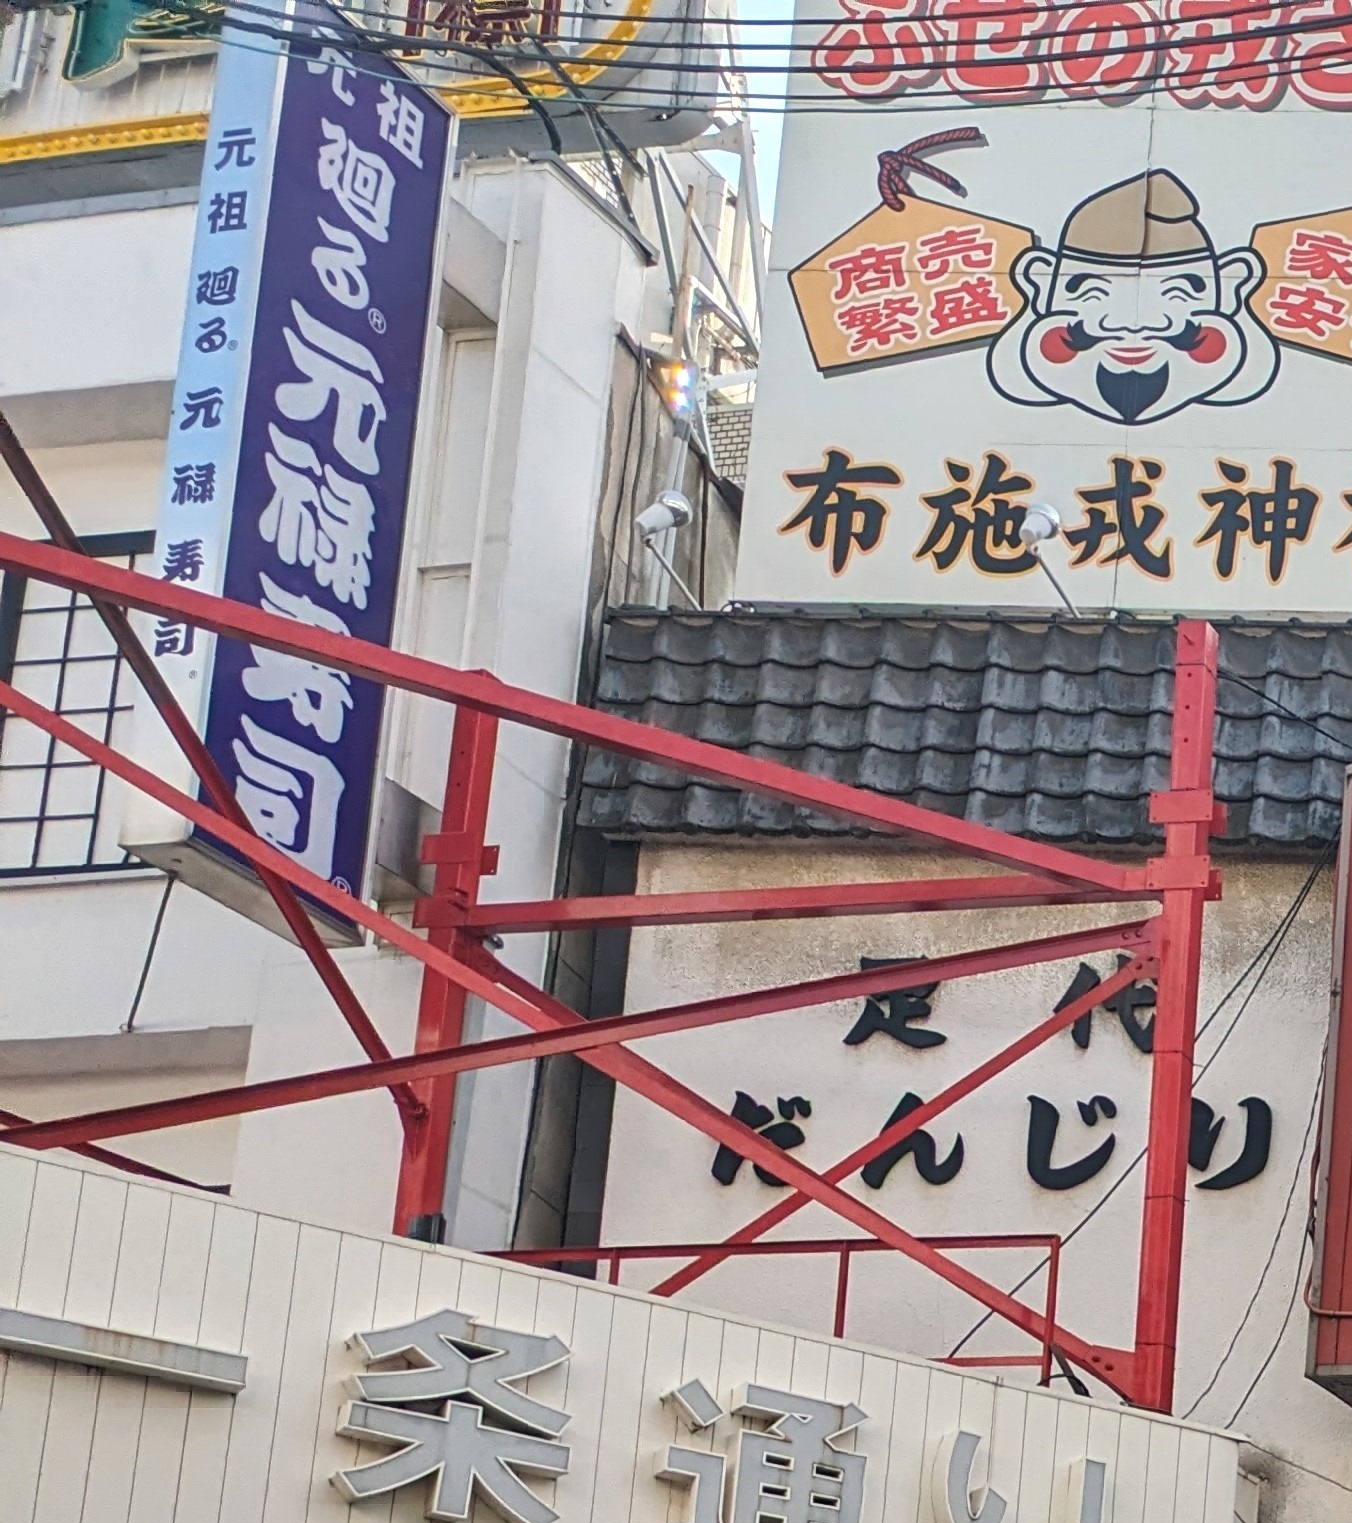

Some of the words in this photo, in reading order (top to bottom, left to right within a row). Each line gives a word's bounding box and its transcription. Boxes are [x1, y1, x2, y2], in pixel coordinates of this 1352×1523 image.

[829, 224, 996, 303] 商売
[838, 275, 1009, 355] 繁盛
[711, 1090, 1272, 1190] だんじり
